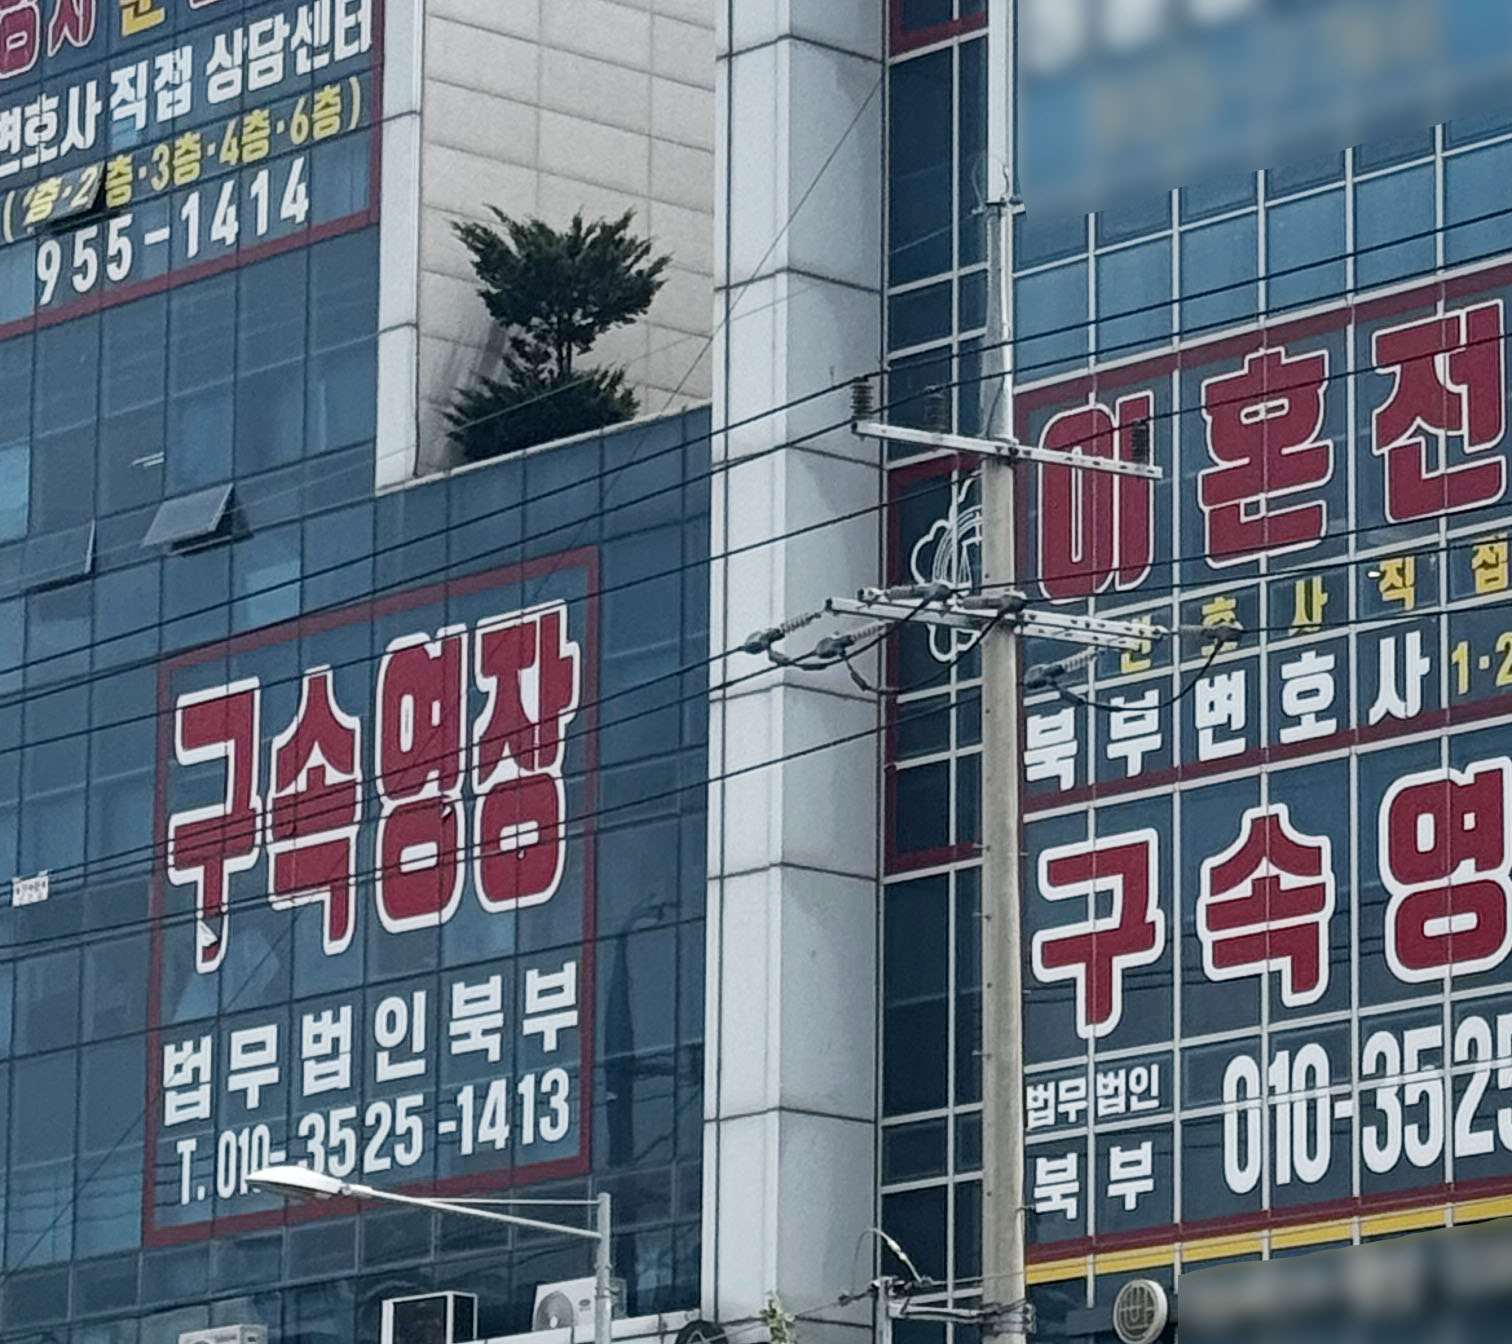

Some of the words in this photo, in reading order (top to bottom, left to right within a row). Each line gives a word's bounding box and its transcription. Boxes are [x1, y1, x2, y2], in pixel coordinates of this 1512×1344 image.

[110, 45, 193, 132] 직접
[37, 156, 310, 307] 955-1414
[167, 598, 582, 975] 구속영장
[1033, 1139, 1154, 1221] 북부
